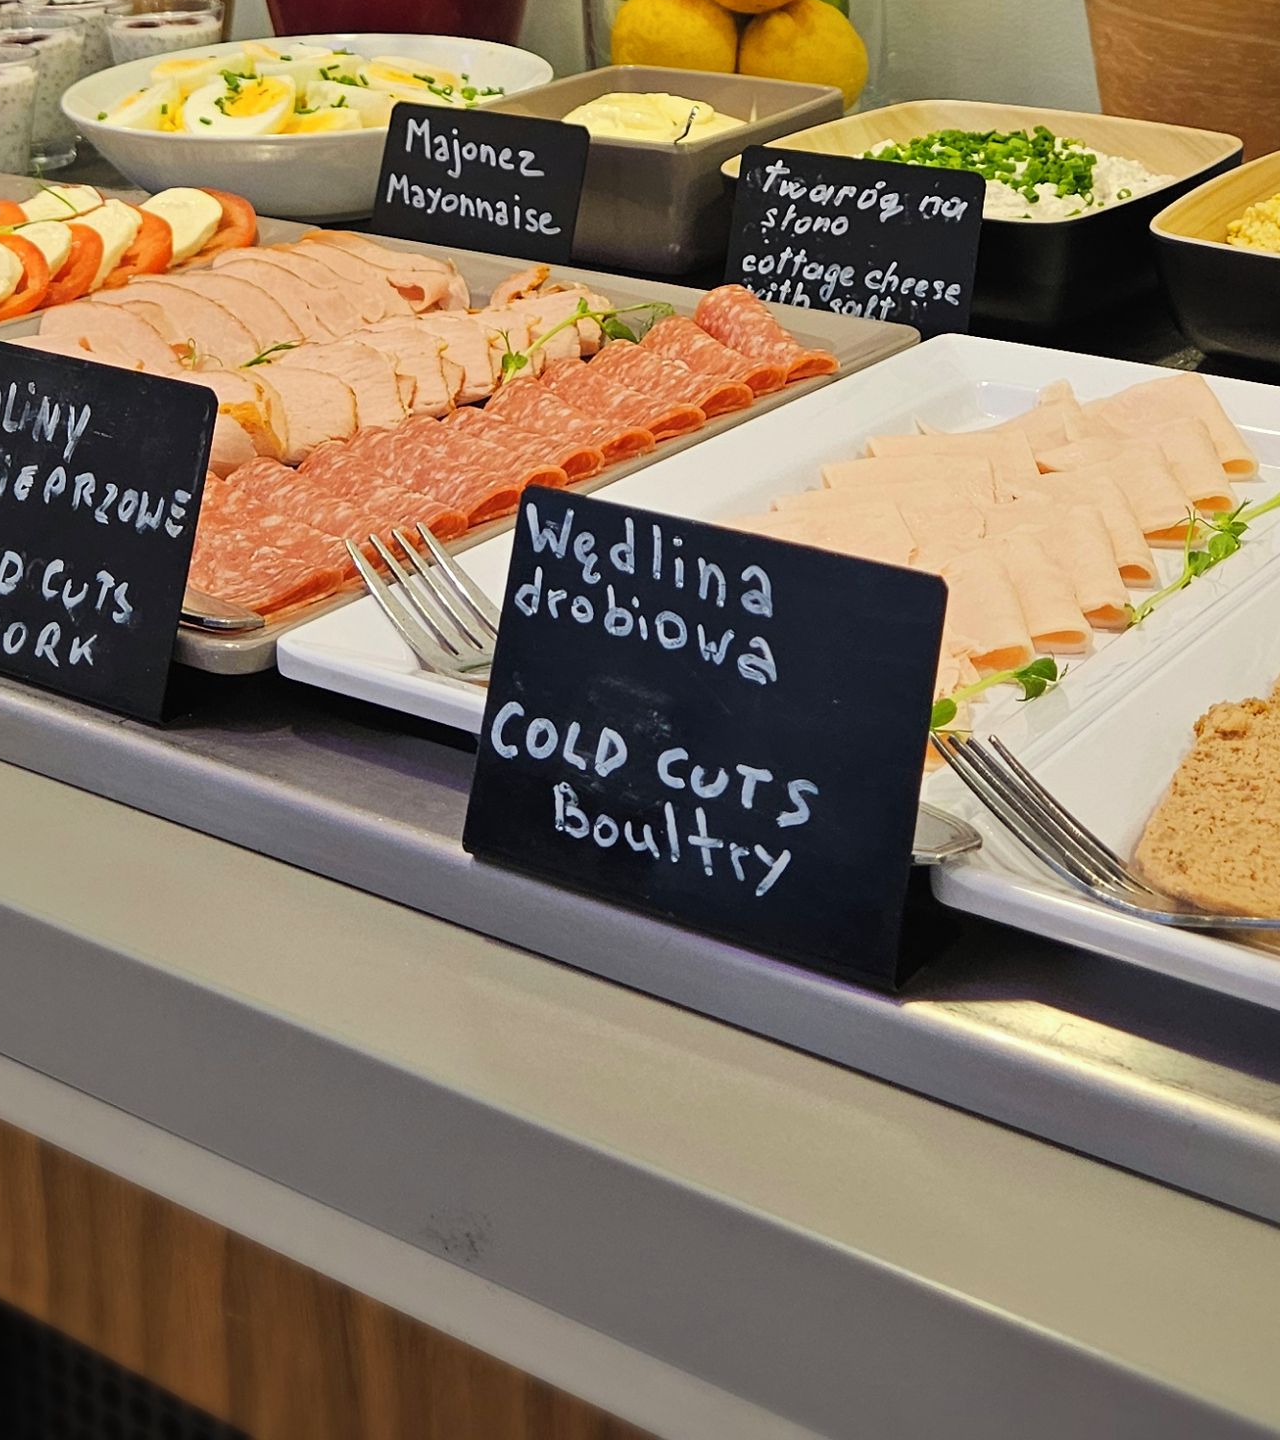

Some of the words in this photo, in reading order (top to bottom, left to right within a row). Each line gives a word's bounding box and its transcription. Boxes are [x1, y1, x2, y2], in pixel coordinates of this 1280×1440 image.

[405, 118, 545, 179] Majonez
[386, 172, 562, 235] Mayonnaise
[918, 193, 969, 221] na
[742, 246, 855, 302] cottage
[864, 261, 962, 306] cheese
[525, 502, 774, 618] Wędlina
[514, 566, 778, 685] drobiowa
[490, 701, 629, 777] COLD
[657, 747, 820, 828] CUTS
